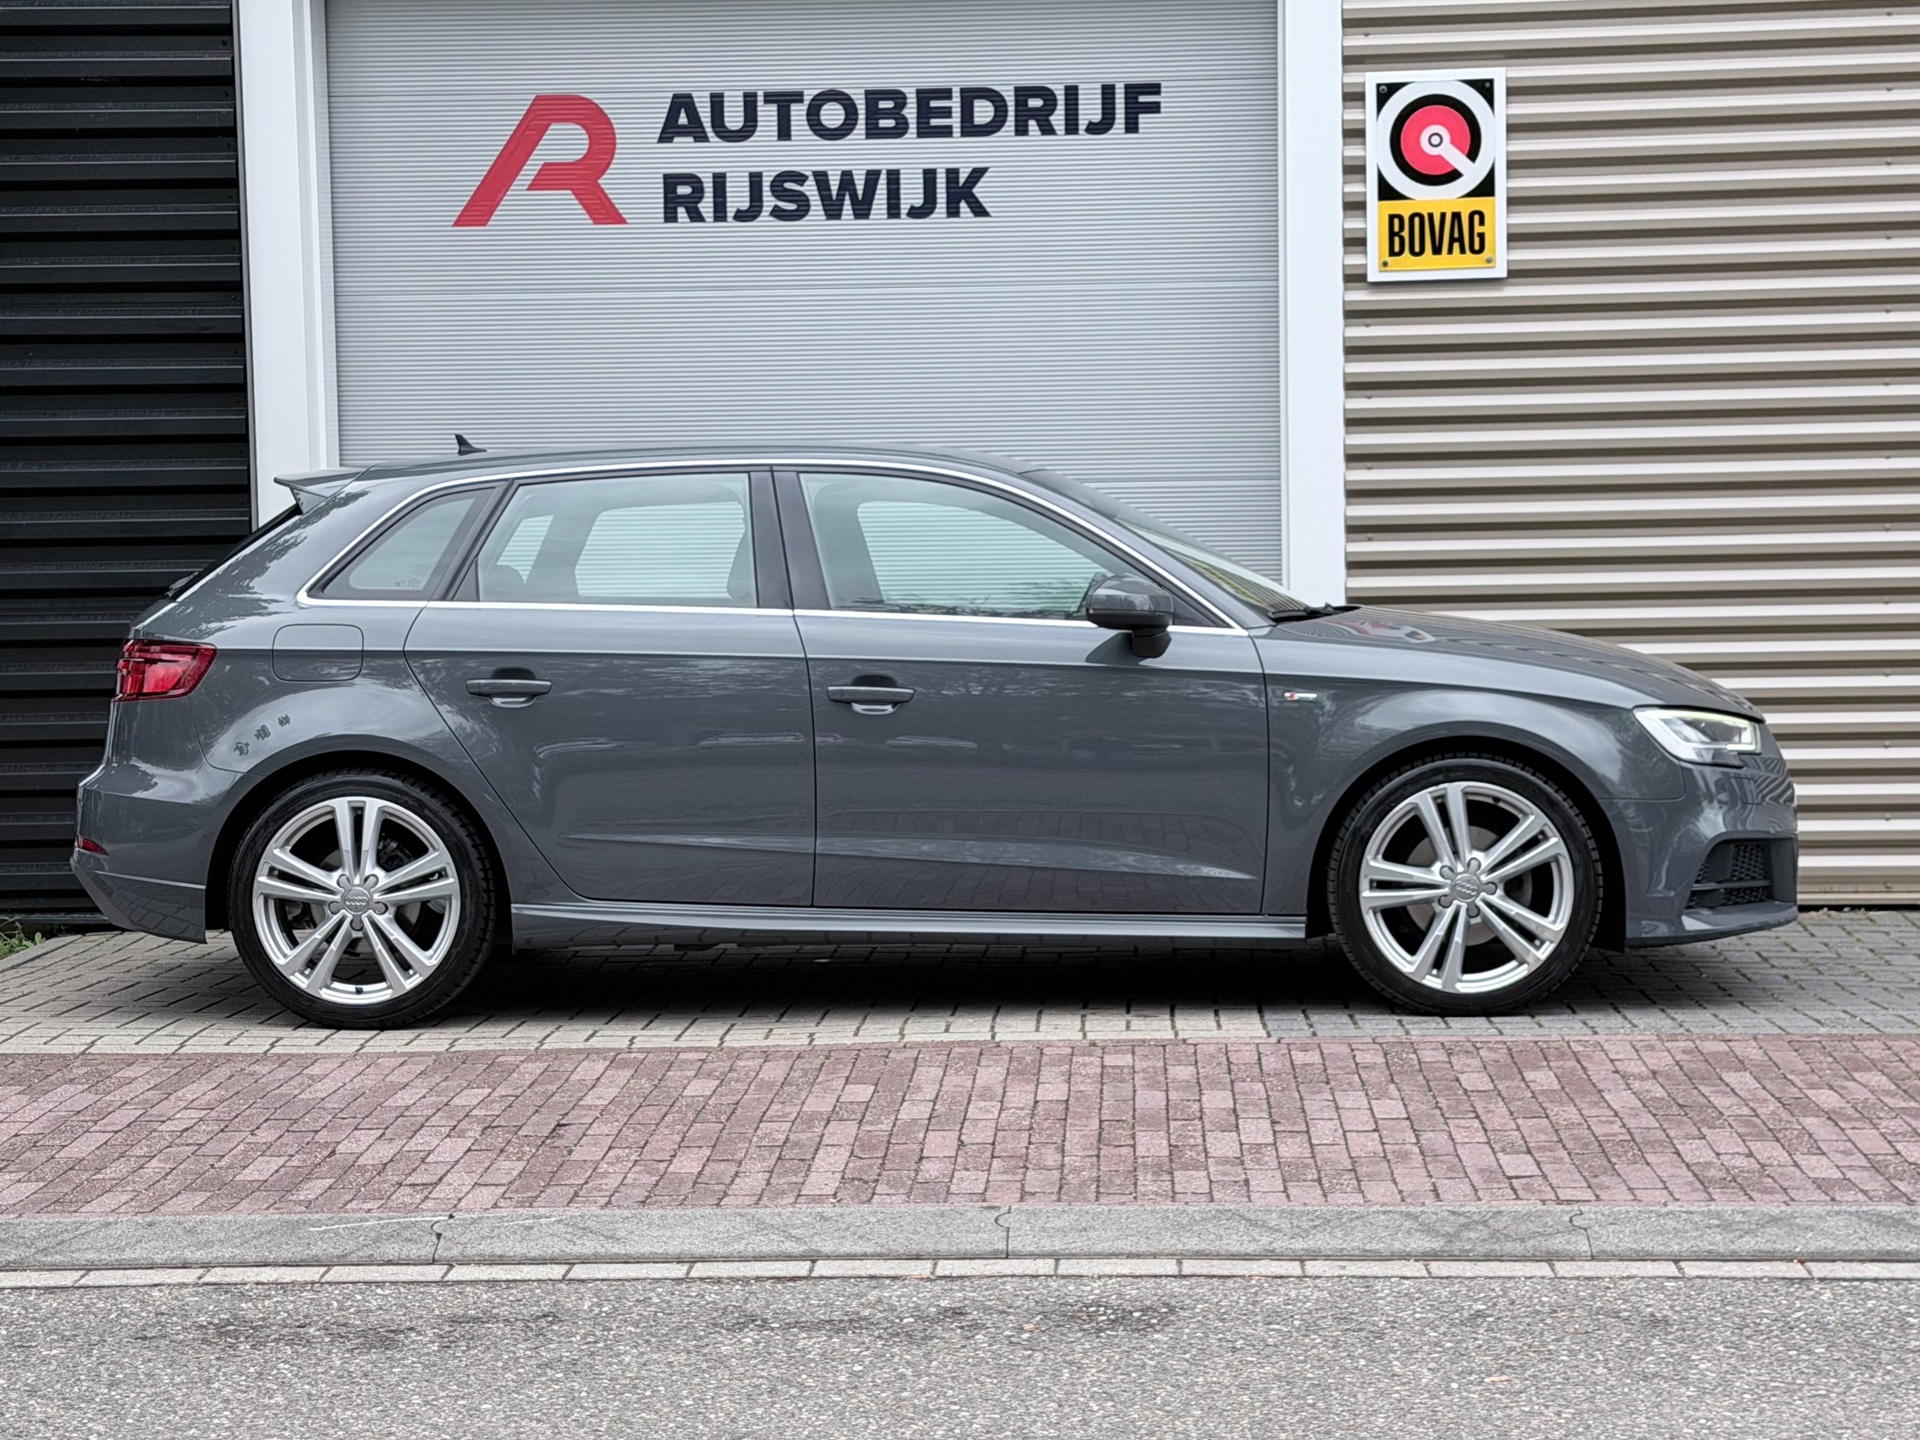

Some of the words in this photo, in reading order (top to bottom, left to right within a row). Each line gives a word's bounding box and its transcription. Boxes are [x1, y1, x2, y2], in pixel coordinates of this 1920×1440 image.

[658, 83, 1161, 143] AUTOBEDRIJF
[663, 168, 989, 222] RIJSWIJK
[1388, 209, 1486, 257] BOVAG
